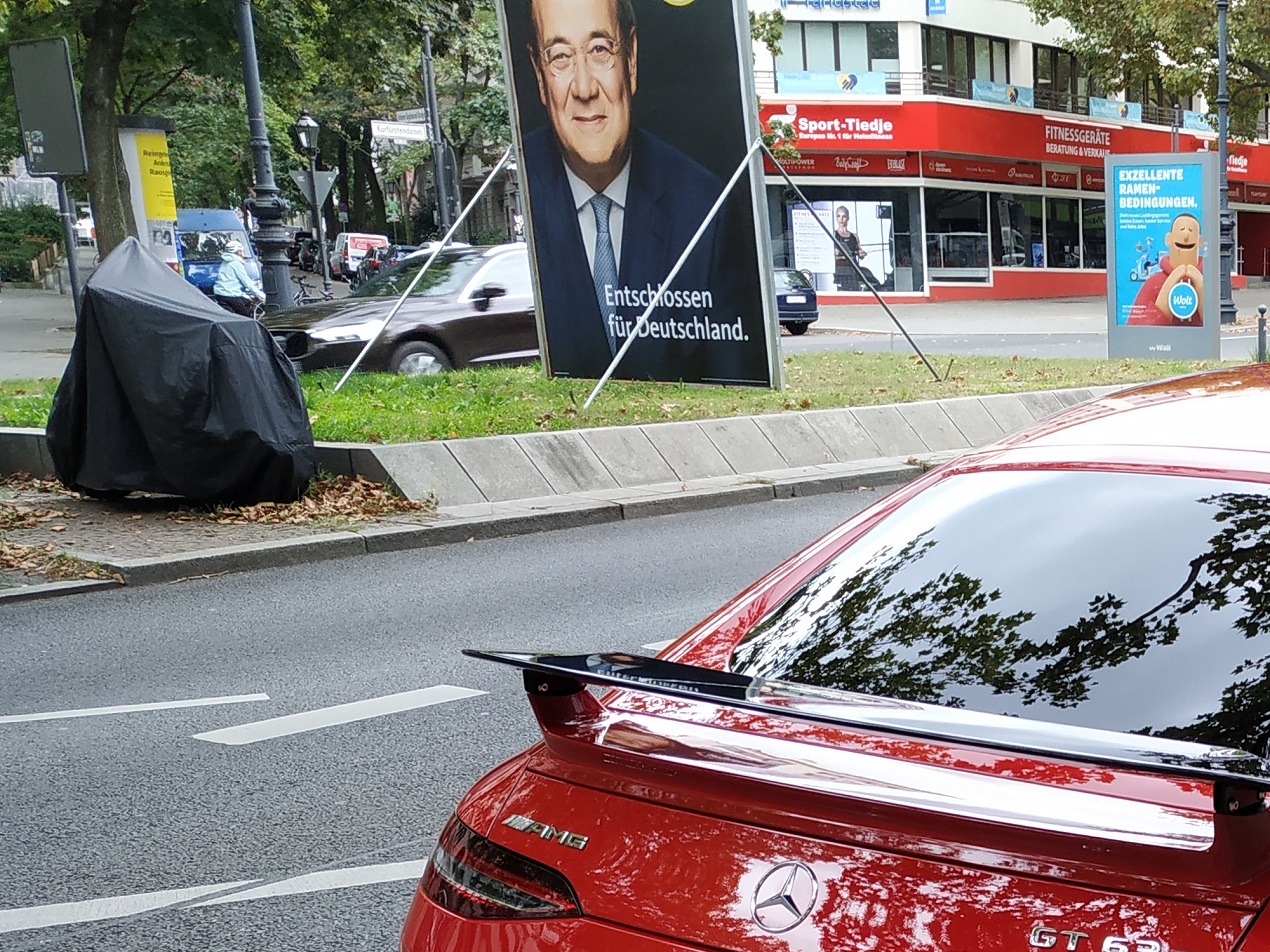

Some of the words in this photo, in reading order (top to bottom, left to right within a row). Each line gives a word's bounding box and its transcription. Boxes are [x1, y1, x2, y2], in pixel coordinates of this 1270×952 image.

[376, 125, 423, 136] Kurfürstendamm
[798, 117, 893, 134] Sport-Tiedje
[799, 132, 826, 140] Europas
[1045, 125, 1110, 145] FITNESSGERÄTE
[1045, 143, 1078, 156] BERATUNG
[1079, 146, 1084, 157] &
[1119, 169, 1184, 181] EXZELLENTE
[1119, 183, 1161, 195] RAMEN-
[1119, 197, 1198, 208] BEDINGUNGEN.
[604, 283, 713, 309] Entschlossen
[1173, 295, 1193, 305] Wolt
[608, 313, 633, 338] für
[637, 315, 749, 342] Deutschland.
[526, 820, 589, 850] AMG
[1029, 926, 1089, 951] GT
